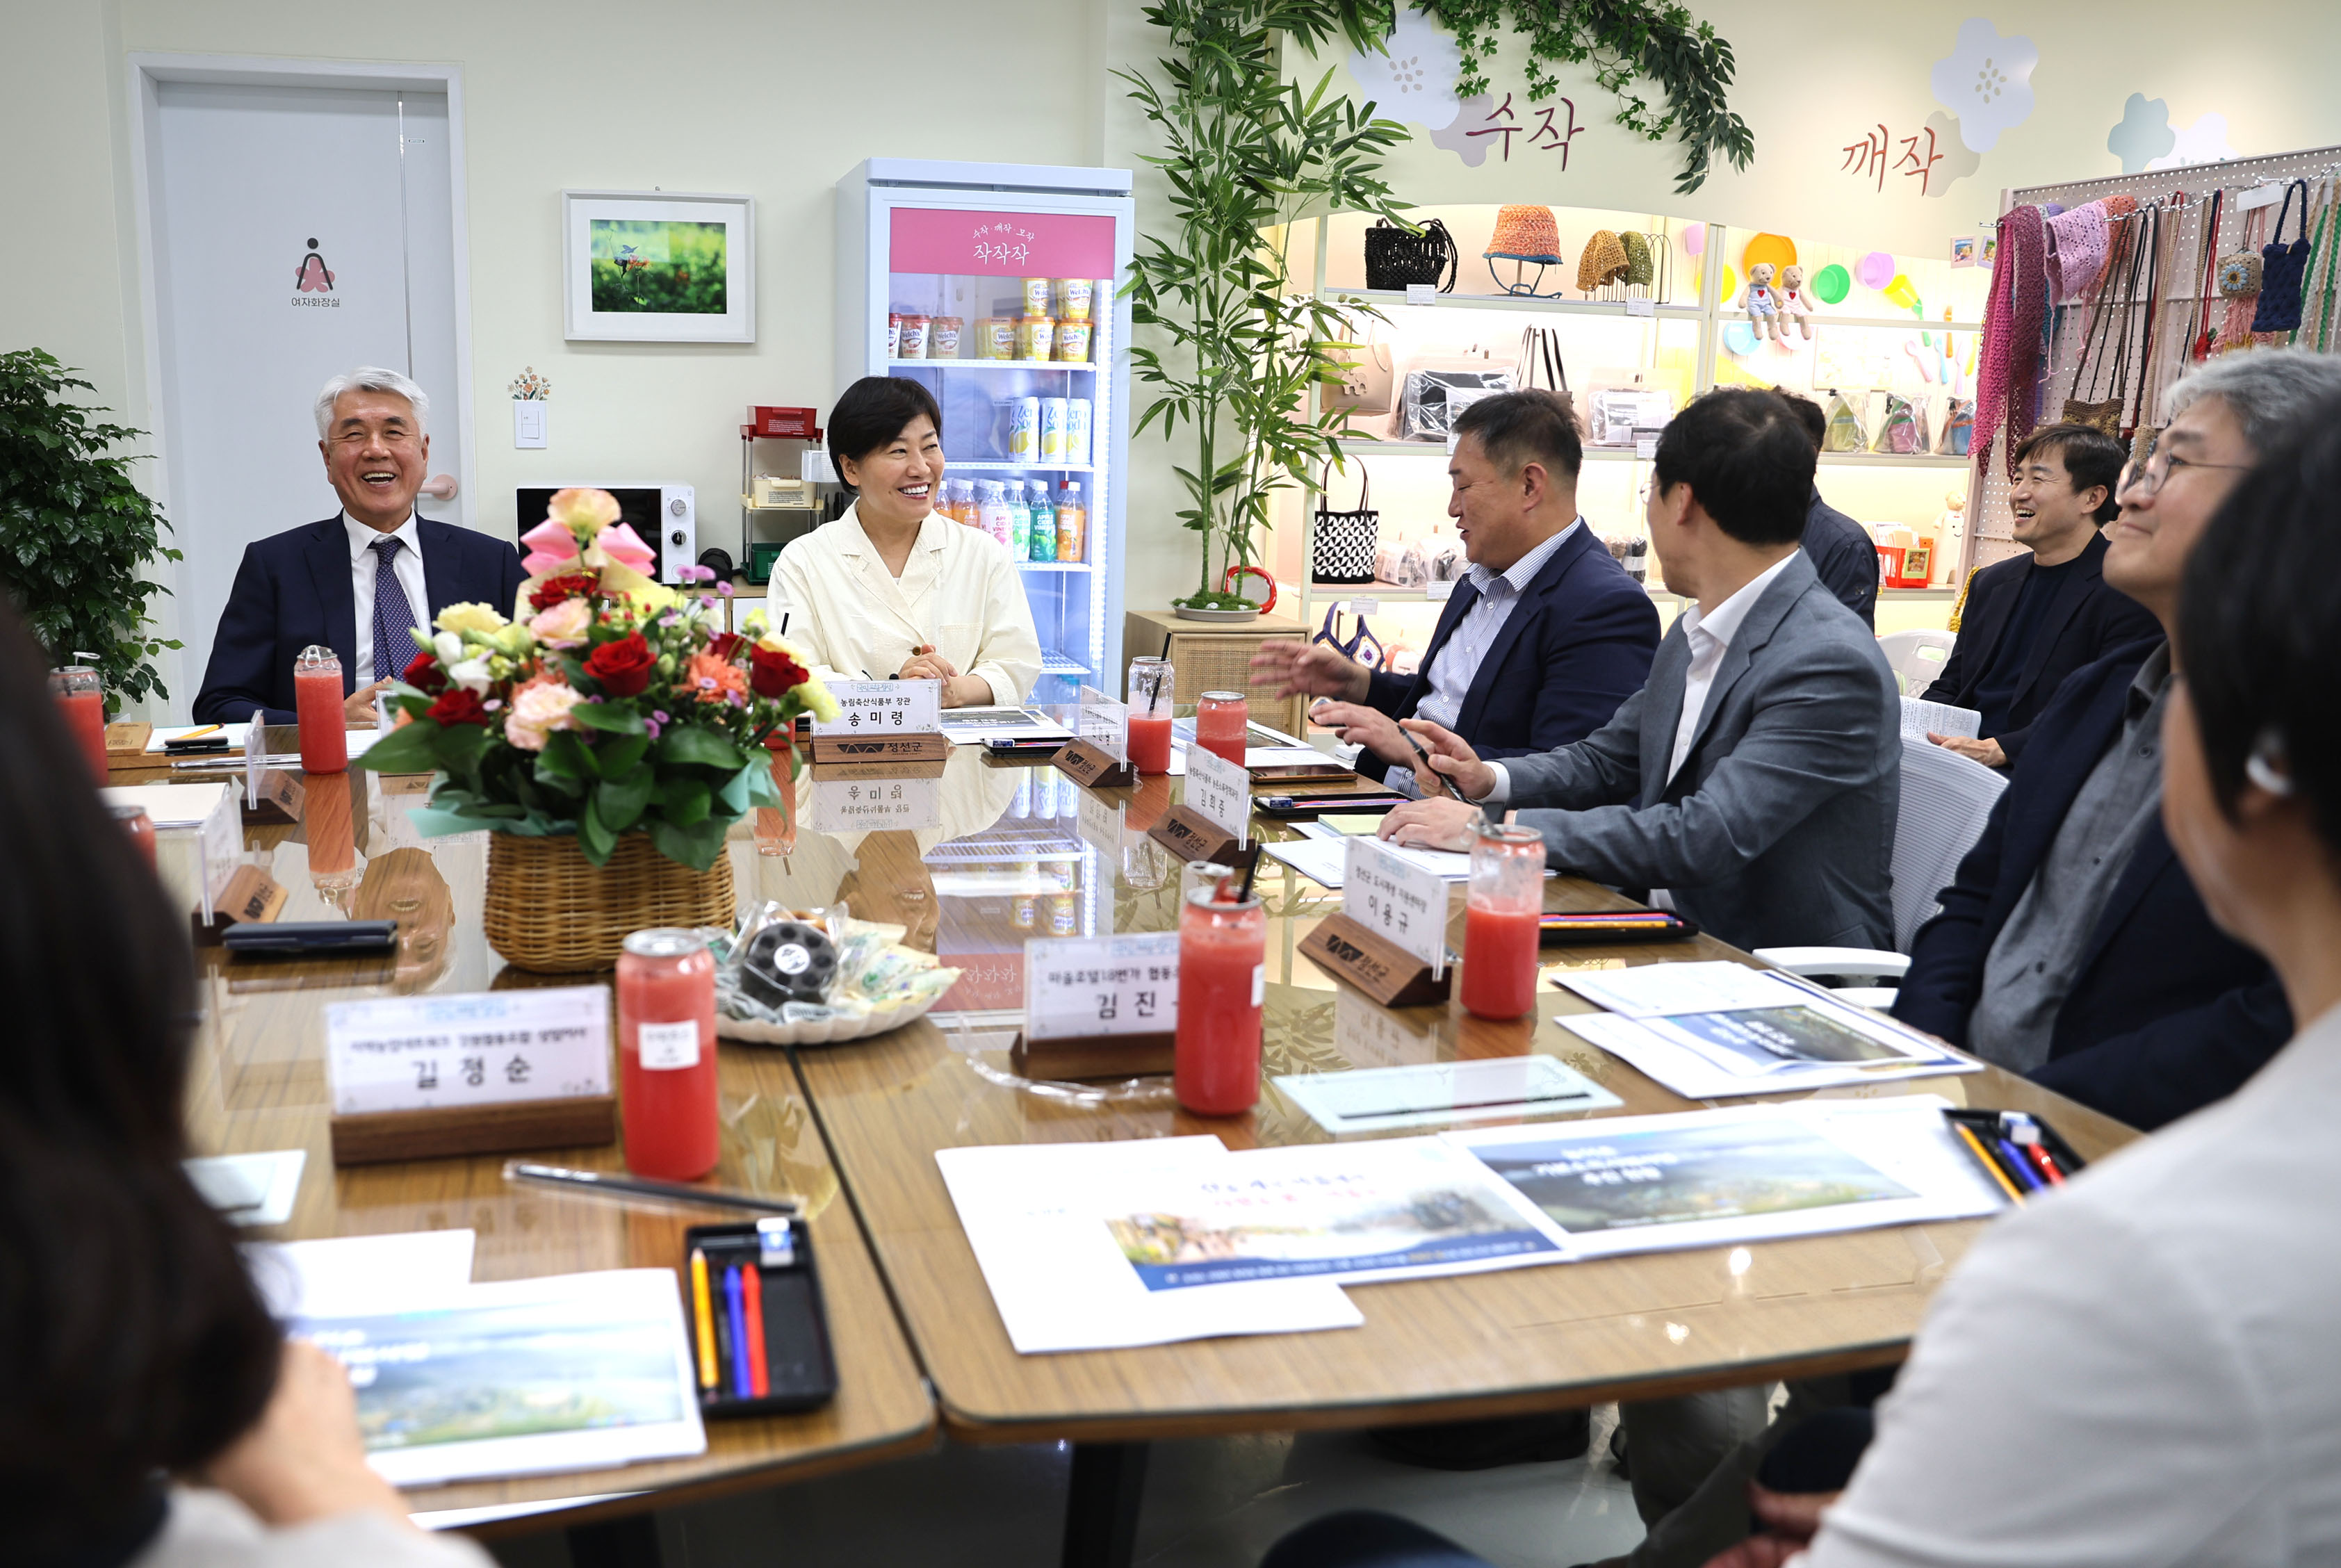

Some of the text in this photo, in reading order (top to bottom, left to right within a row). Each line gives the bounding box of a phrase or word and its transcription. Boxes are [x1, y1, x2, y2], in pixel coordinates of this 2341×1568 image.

[1465, 92, 1585, 172] 수작
[1840, 123, 1945, 197] 깨작
[972, 241, 1030, 267] 작작작
[291, 296, 340, 308] 여자화장실
[840, 696, 911, 708] 농림축산식품부 장관
[888, 742, 923, 753] 정선군
